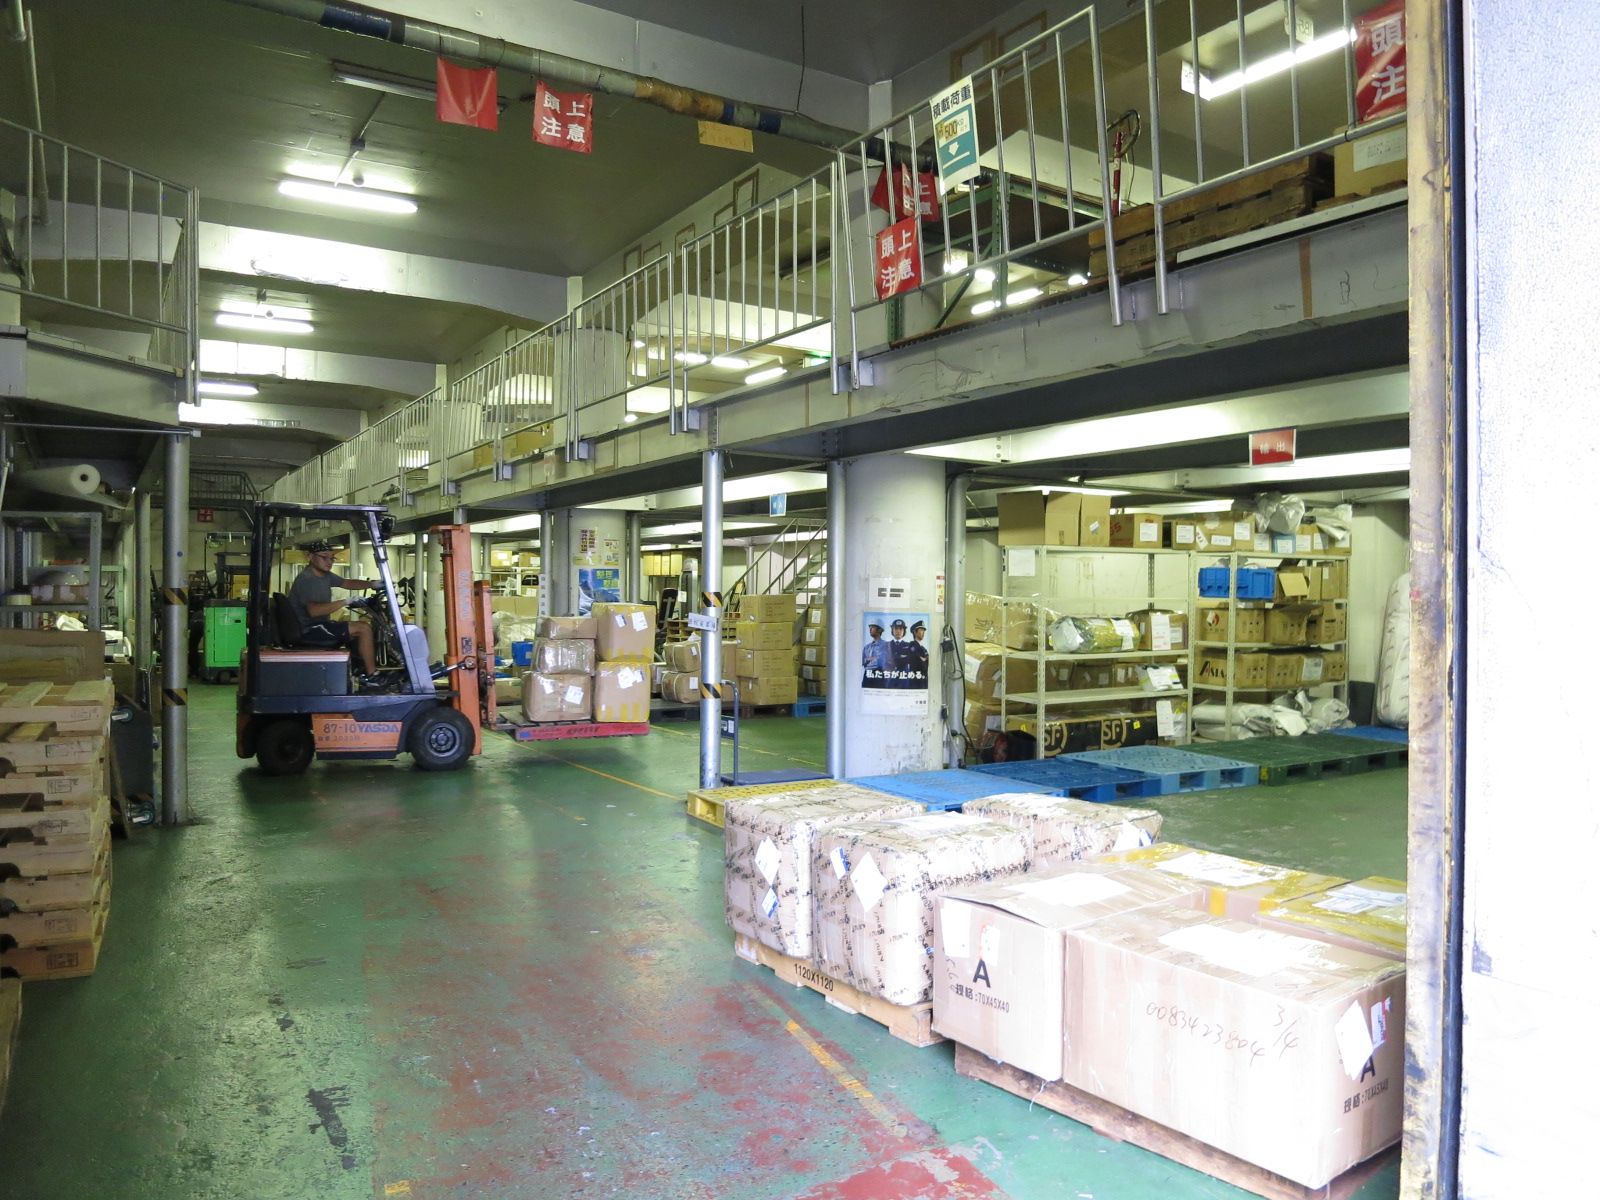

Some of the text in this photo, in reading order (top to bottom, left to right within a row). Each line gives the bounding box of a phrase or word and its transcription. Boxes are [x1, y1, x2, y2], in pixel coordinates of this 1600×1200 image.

[543, 91, 586, 117] 頭上
[932, 84, 971, 119] 積載荷重
[541, 116, 586, 144] 注意
[881, 229, 912, 259] 頭上
[881, 258, 915, 288] 注意
[866, 670, 926, 680] 私たちが止める。
[794, 963, 834, 991] 1120X1120
[973, 959, 991, 988] A
[1360, 1056, 1376, 1083] A
